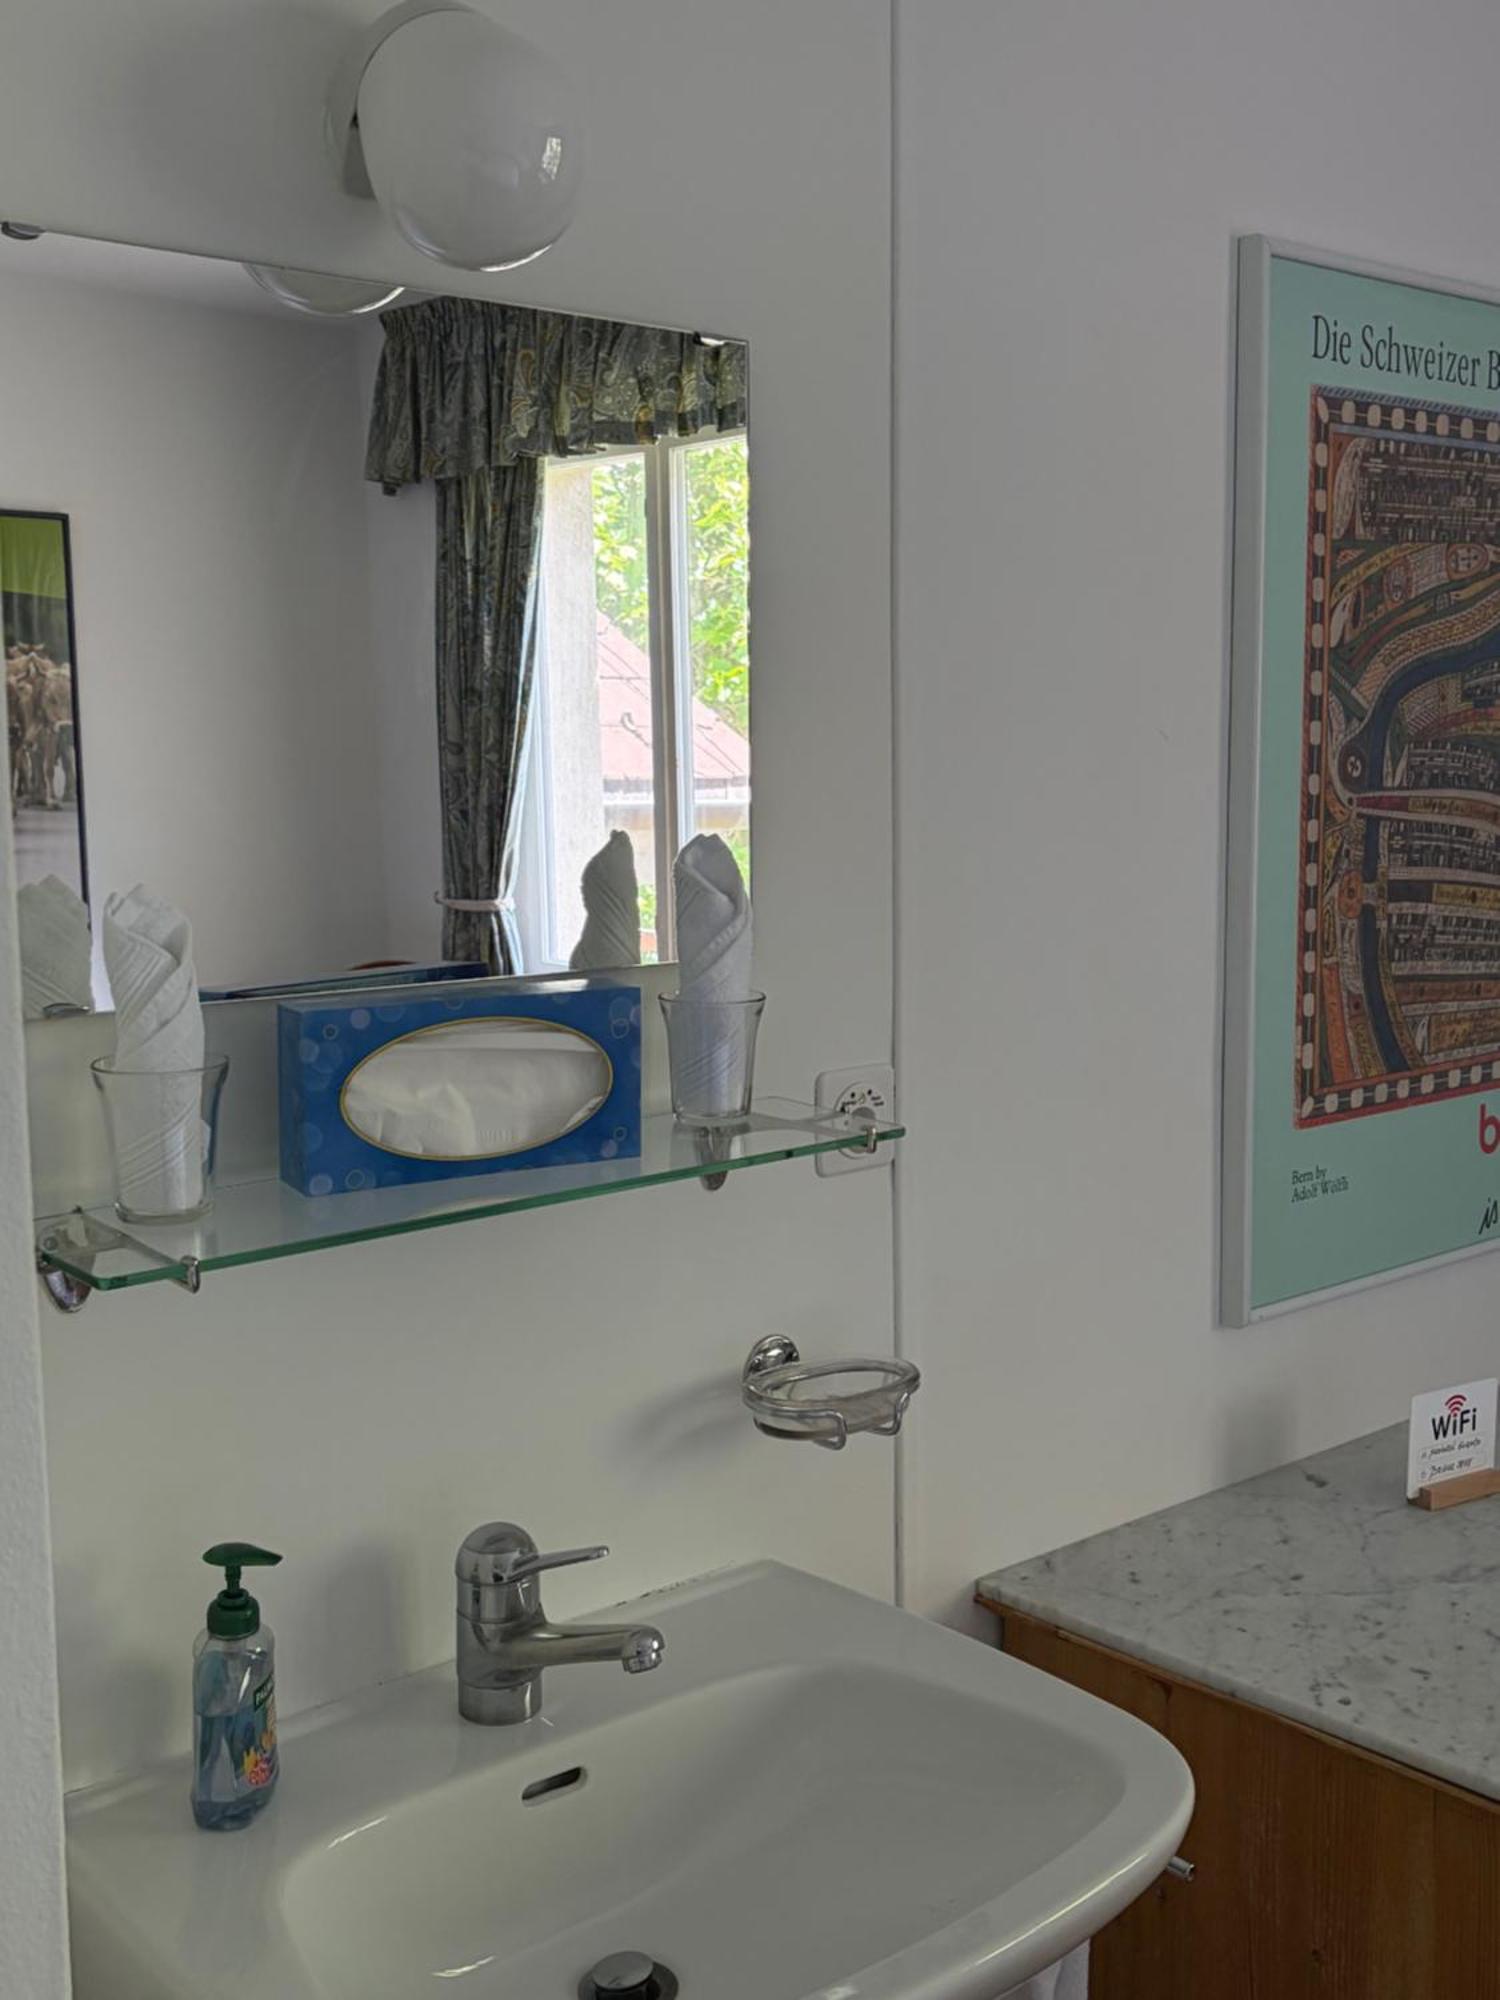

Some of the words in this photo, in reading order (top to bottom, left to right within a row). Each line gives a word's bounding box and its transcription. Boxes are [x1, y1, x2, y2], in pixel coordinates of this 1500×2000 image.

[1312, 315, 1351, 365] Die
[1360, 324, 1481, 386] Schweizer
[1431, 1408, 1478, 1441] WiFi
